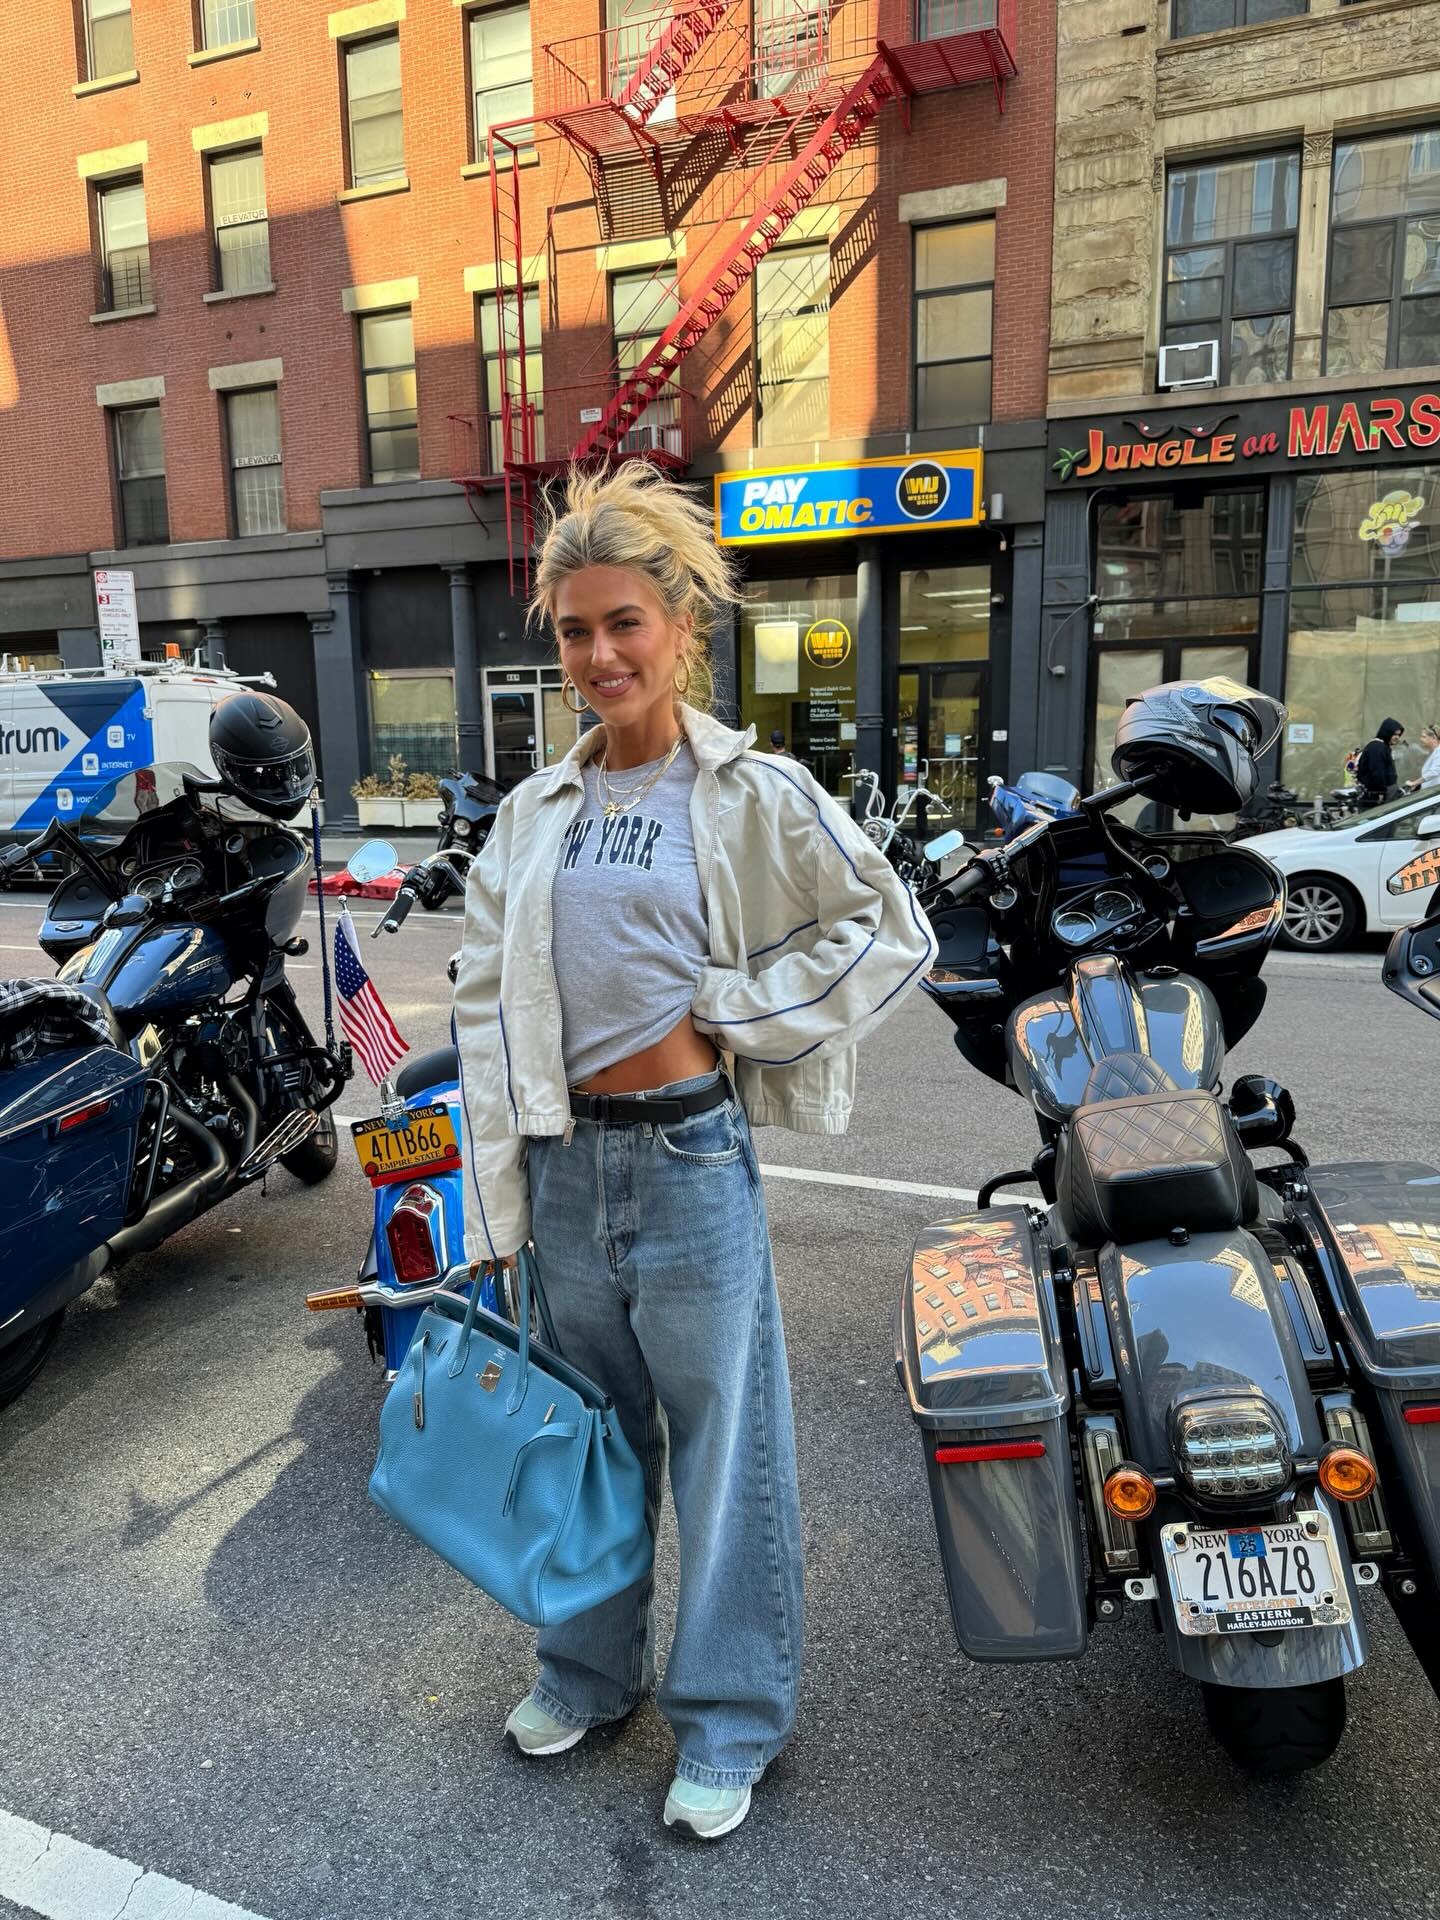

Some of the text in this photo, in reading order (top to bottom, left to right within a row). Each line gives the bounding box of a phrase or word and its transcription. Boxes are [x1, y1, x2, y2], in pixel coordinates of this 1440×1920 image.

[222, 210, 265, 224] ELEVATOR
[1076, 394, 1440, 478] JUNGLE on MARS
[239, 455, 279, 465] ELEVATOR
[743, 476, 809, 507] PAY
[740, 498, 873, 532] OMATIC
[101, 761, 133, 769] INTERNET
[593, 814, 665, 873] YORK
[363, 1107, 436, 1132] NEW YORK
[371, 1122, 442, 1162] 47TB66
[380, 1150, 441, 1171] EMPIRE STATE
[1191, 1527, 1305, 1550] NEW YORK
[1239, 1540, 1257, 1552] 25
[1196, 1546, 1316, 1602] 216AZ8
[1227, 1618, 1303, 1630] HARLEY-DAVIDSON
[1235, 1609, 1292, 1621] EASTERN
